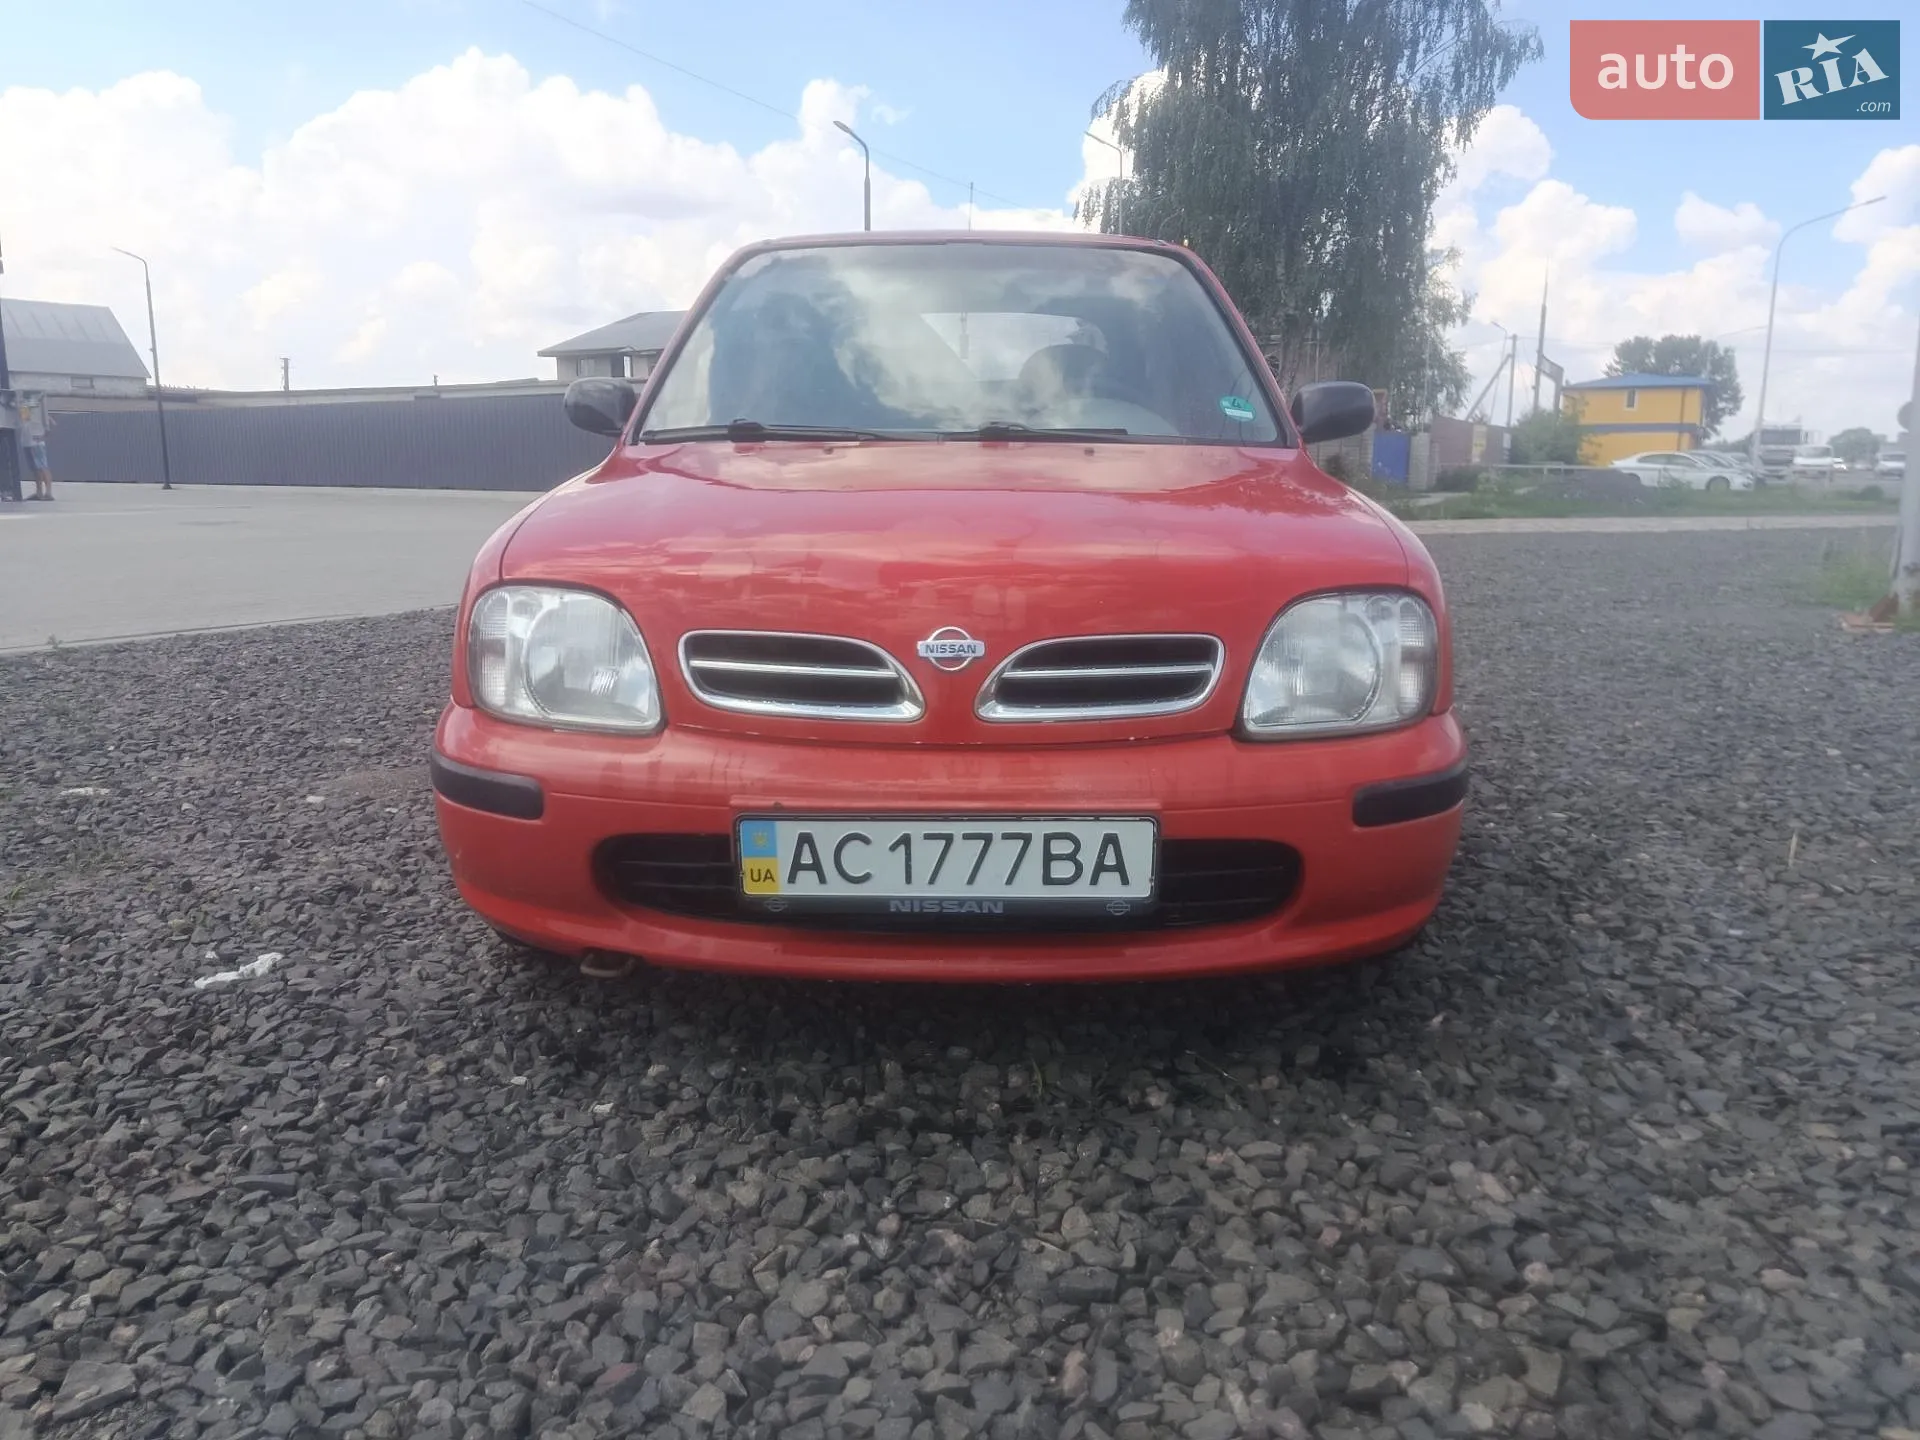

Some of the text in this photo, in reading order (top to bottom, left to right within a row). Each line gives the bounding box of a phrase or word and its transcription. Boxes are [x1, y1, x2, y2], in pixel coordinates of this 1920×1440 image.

[925, 644, 976, 654] NISSAN
[750, 867, 775, 884] UA
[889, 901, 1004, 914] NISSAN
